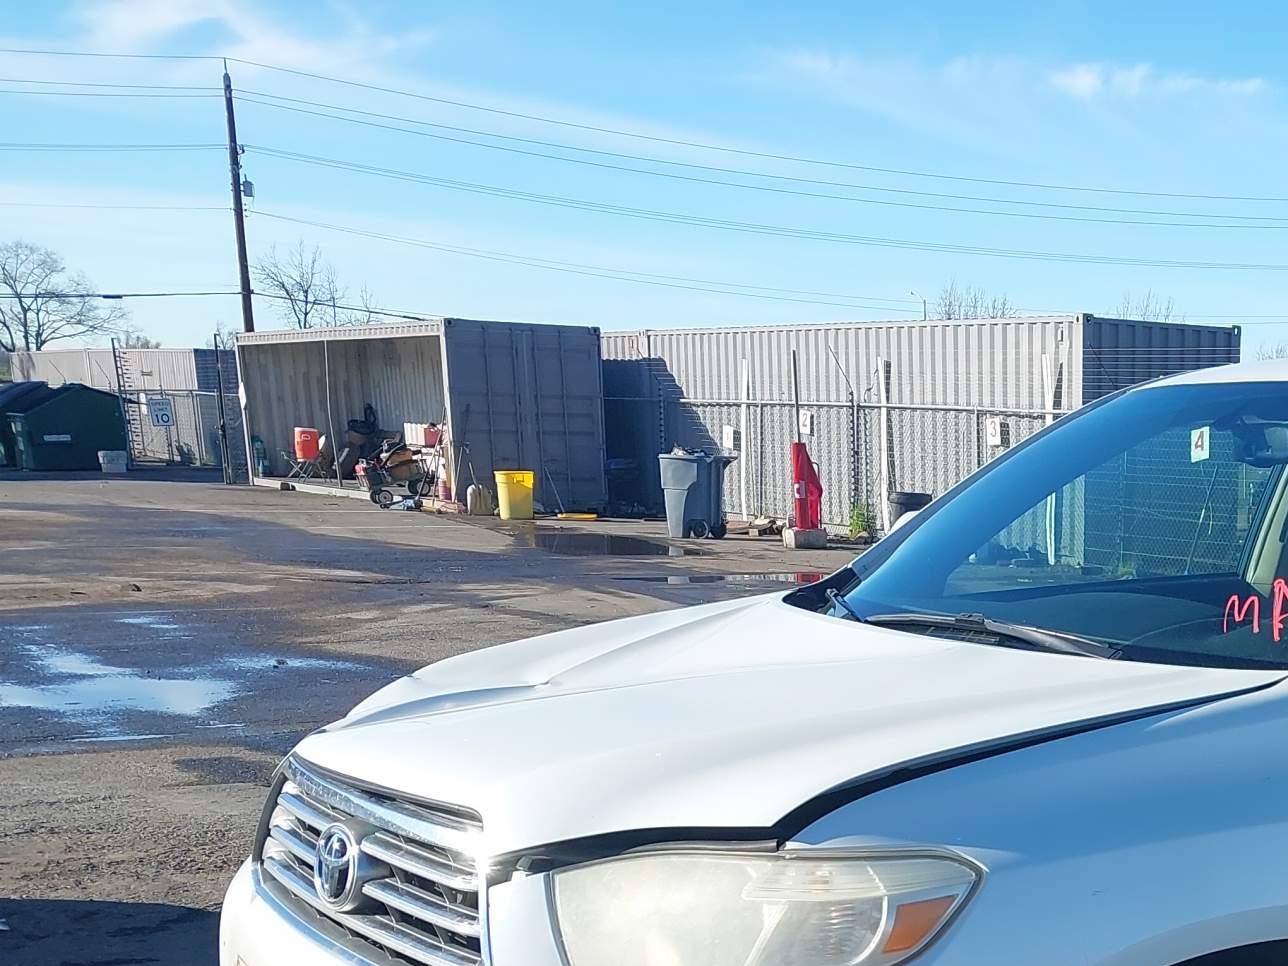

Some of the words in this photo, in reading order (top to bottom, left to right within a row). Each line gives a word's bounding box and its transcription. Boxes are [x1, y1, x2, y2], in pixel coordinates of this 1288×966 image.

[155, 413, 170, 423] 10
[801, 413, 808, 427] 2
[990, 420, 997, 437] 3
[1194, 430, 1204, 451] 4
